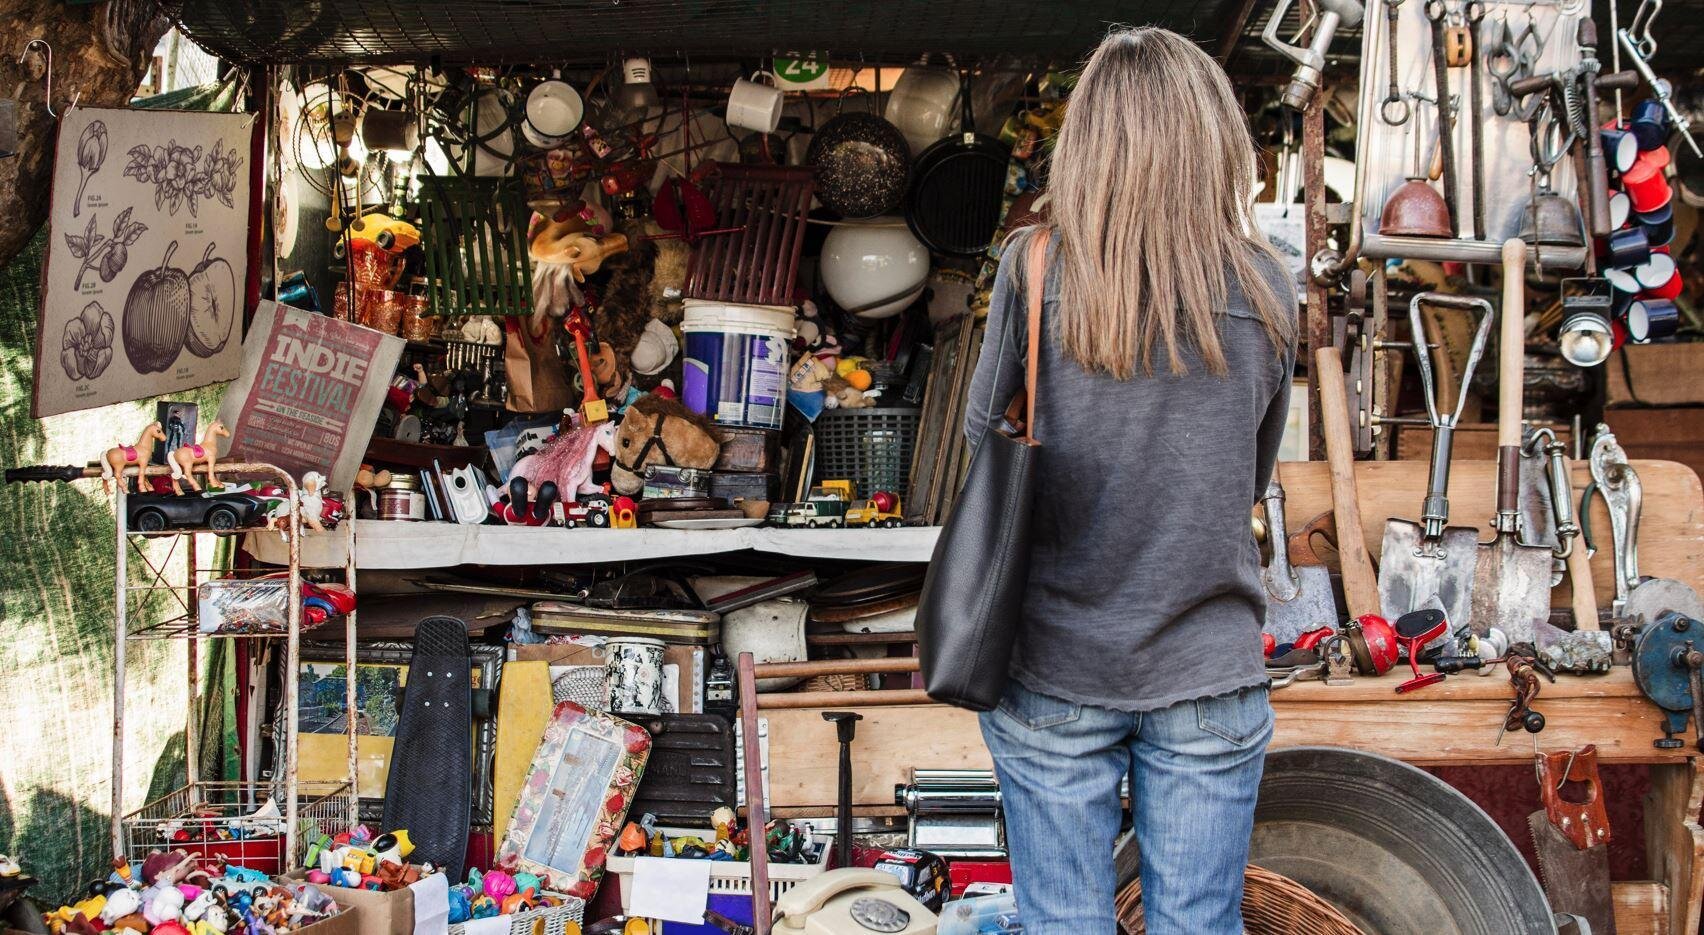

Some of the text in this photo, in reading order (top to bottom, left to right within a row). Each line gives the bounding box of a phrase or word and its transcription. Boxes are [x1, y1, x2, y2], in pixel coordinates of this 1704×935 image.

[784, 51, 819, 75] 24
[270, 335, 368, 385] INDIE
[260, 362, 355, 414] FESTIVAL
[286, 407, 299, 416] THE
